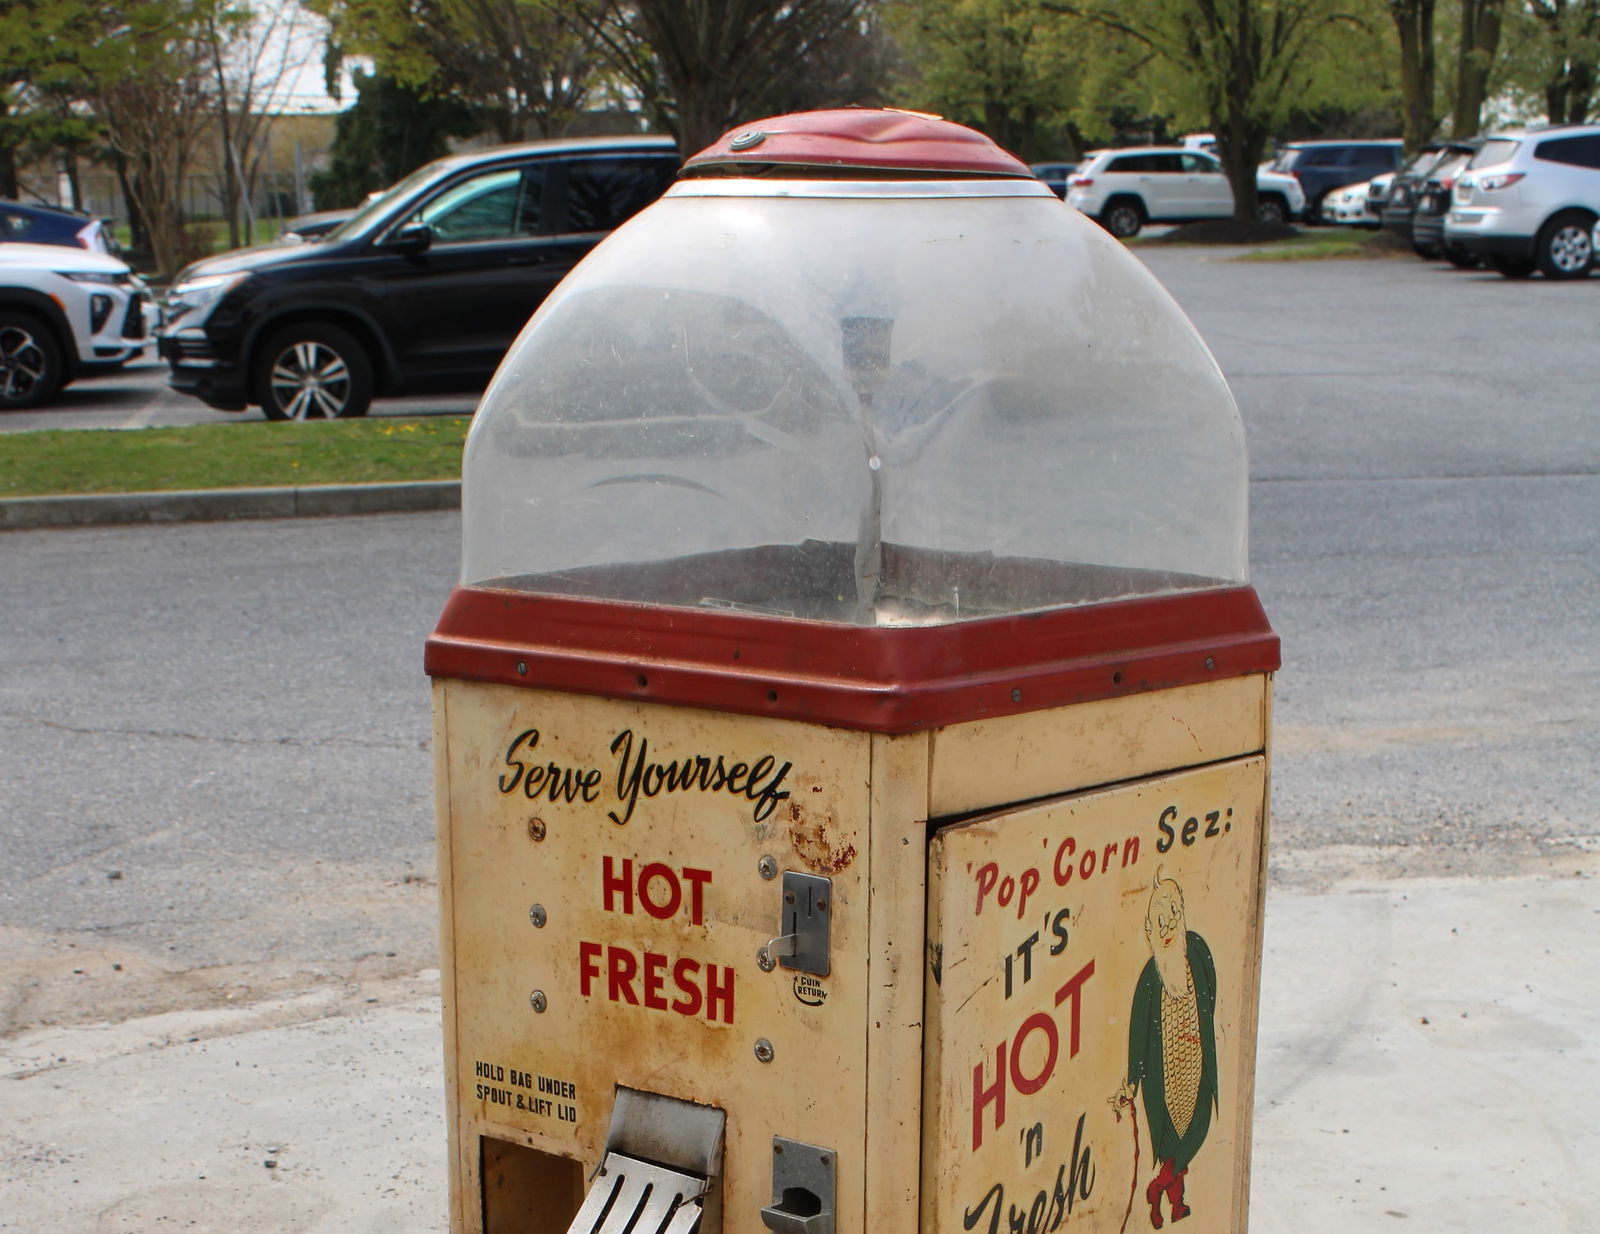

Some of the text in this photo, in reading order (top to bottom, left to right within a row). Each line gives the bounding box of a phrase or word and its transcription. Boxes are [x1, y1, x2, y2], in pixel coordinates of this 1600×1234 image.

[500, 729, 793, 825] Serve Yourself
[1156, 805, 1233, 853] Sez:
[602, 856, 712, 926] HOT
[579, 941, 735, 1025] FRESH
[1005, 908, 1070, 1000] IT'S
[797, 986, 827, 999] RETURN
[476, 1061, 576, 1100] HOLD BAG UNDER
[972, 958, 1096, 1153] HOT
[477, 1084, 576, 1123] SPOUT & LIFT LID
